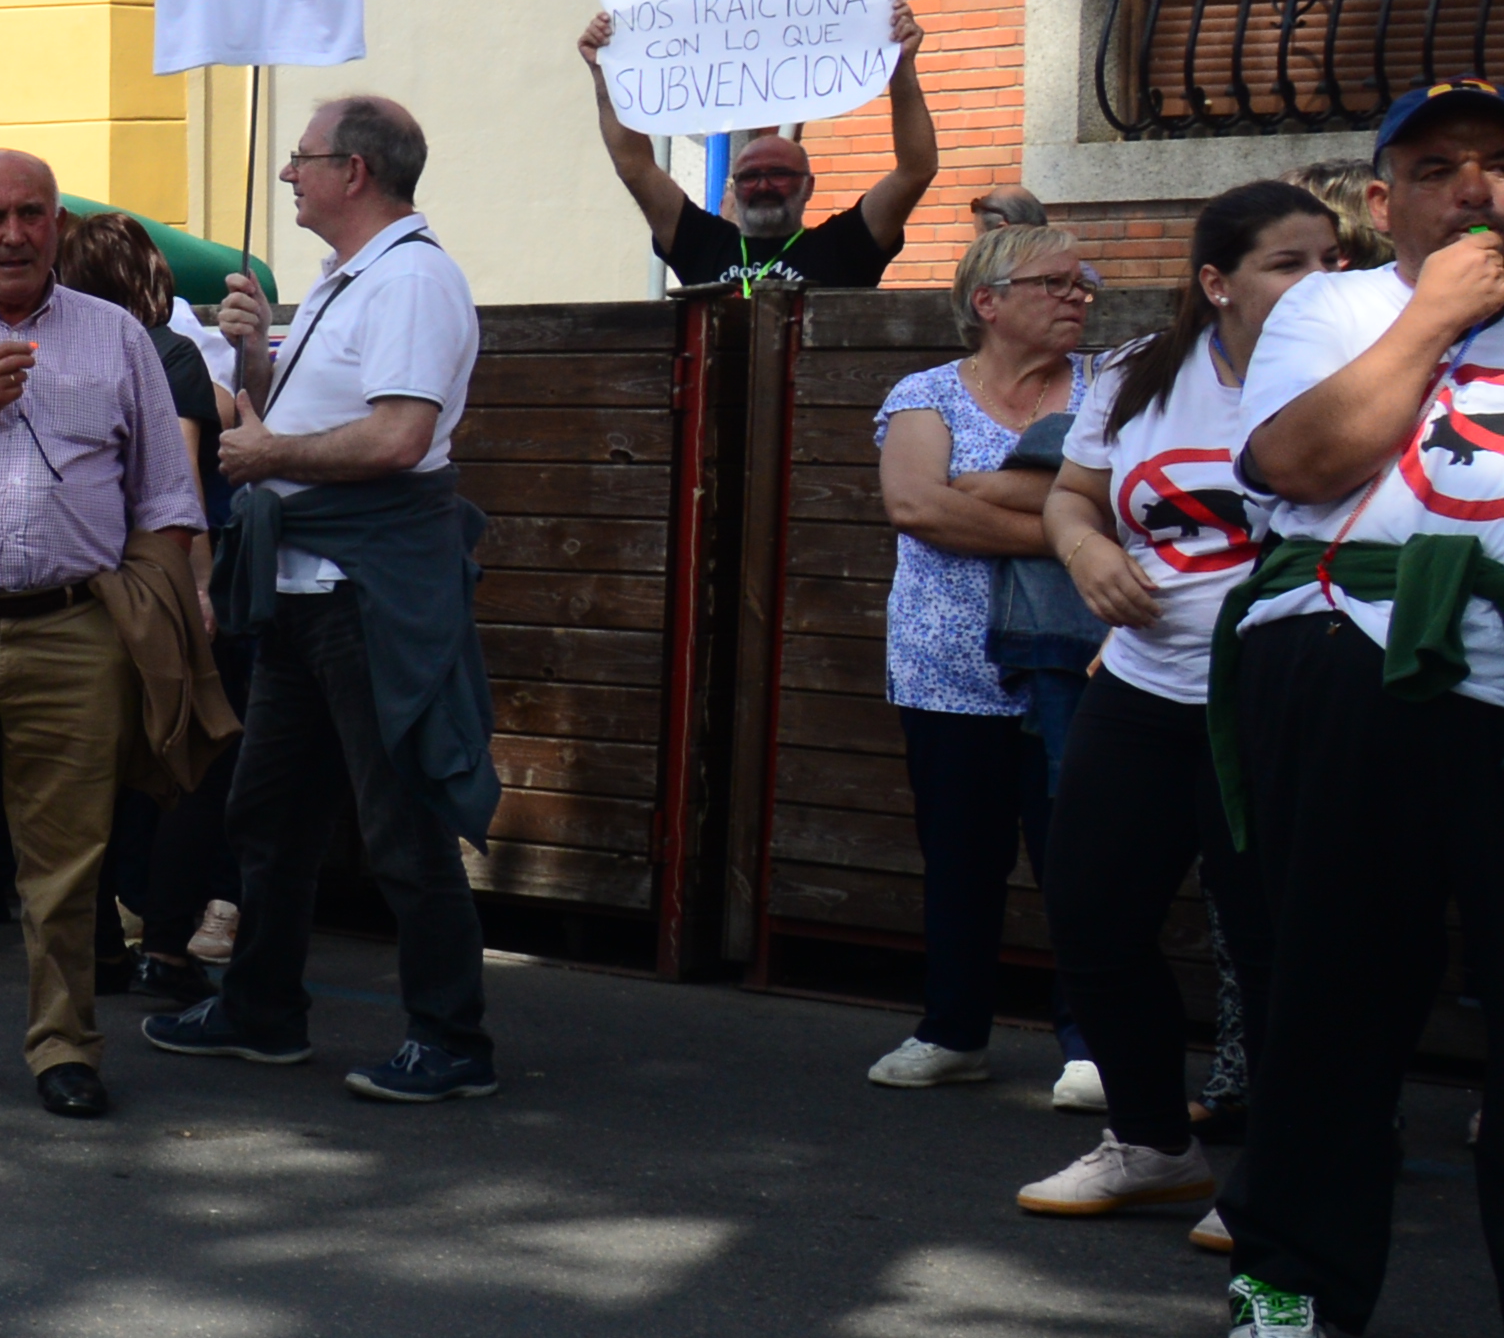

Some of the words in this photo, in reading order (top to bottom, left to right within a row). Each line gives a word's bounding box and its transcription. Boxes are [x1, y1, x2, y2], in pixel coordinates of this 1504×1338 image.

[609, 0, 674, 36] NOS
[645, 33, 700, 59] CON
[725, 28, 761, 51] LO
[782, 22, 844, 48] QUE
[615, 47, 888, 116] SUBVENCIONA
